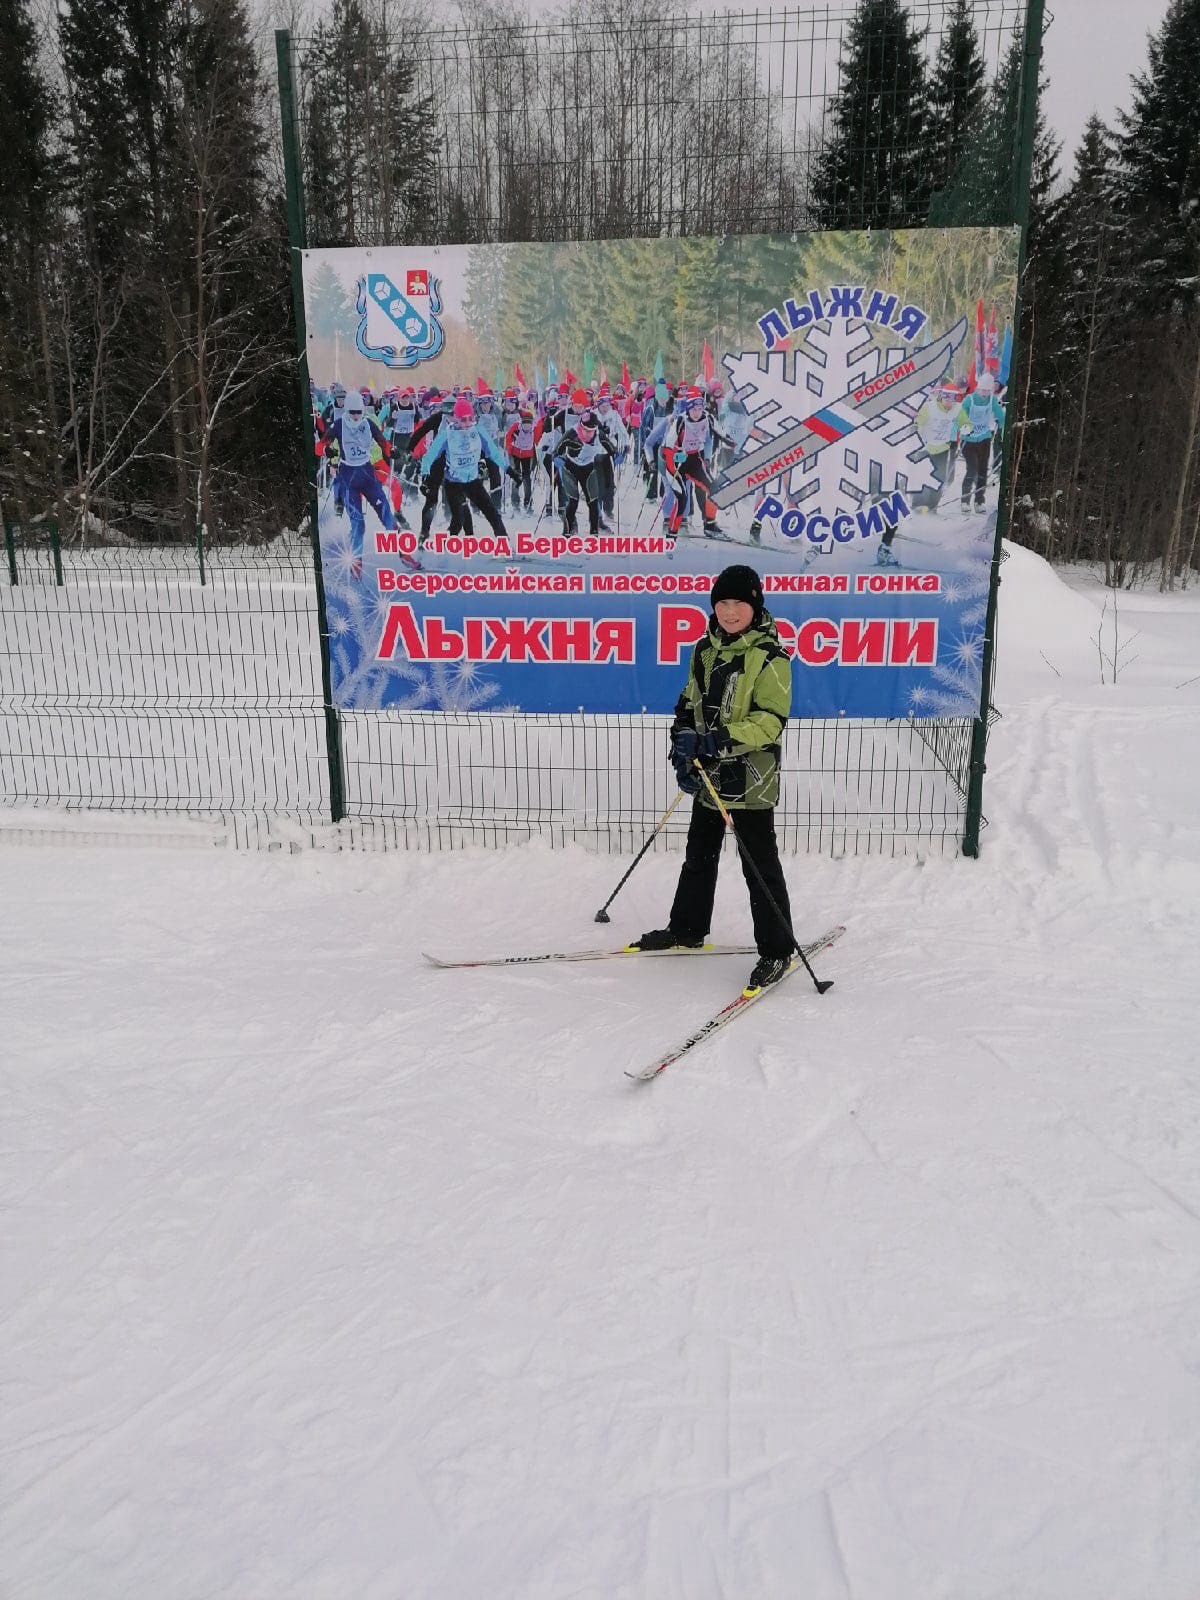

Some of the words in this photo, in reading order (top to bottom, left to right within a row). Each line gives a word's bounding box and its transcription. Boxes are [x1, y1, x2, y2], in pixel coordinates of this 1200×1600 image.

[757, 286, 928, 350] ЛЫЖНЯ
[746, 446, 806, 489] ЛЫЖНЯ
[853, 359, 916, 403] РОССИИ
[754, 490, 911, 543] РОССИИ
[376, 533, 417, 553] МО
[425, 533, 511, 558] «Город
[517, 533, 676, 558] Березники»
[378, 568, 584, 595] Всероссийская
[592, 574, 719, 592] массова
[760, 574, 848, 592] жная
[856, 574, 940, 592] гонка
[377, 604, 634, 663] Лыжня
[658, 606, 939, 665] Рсии
